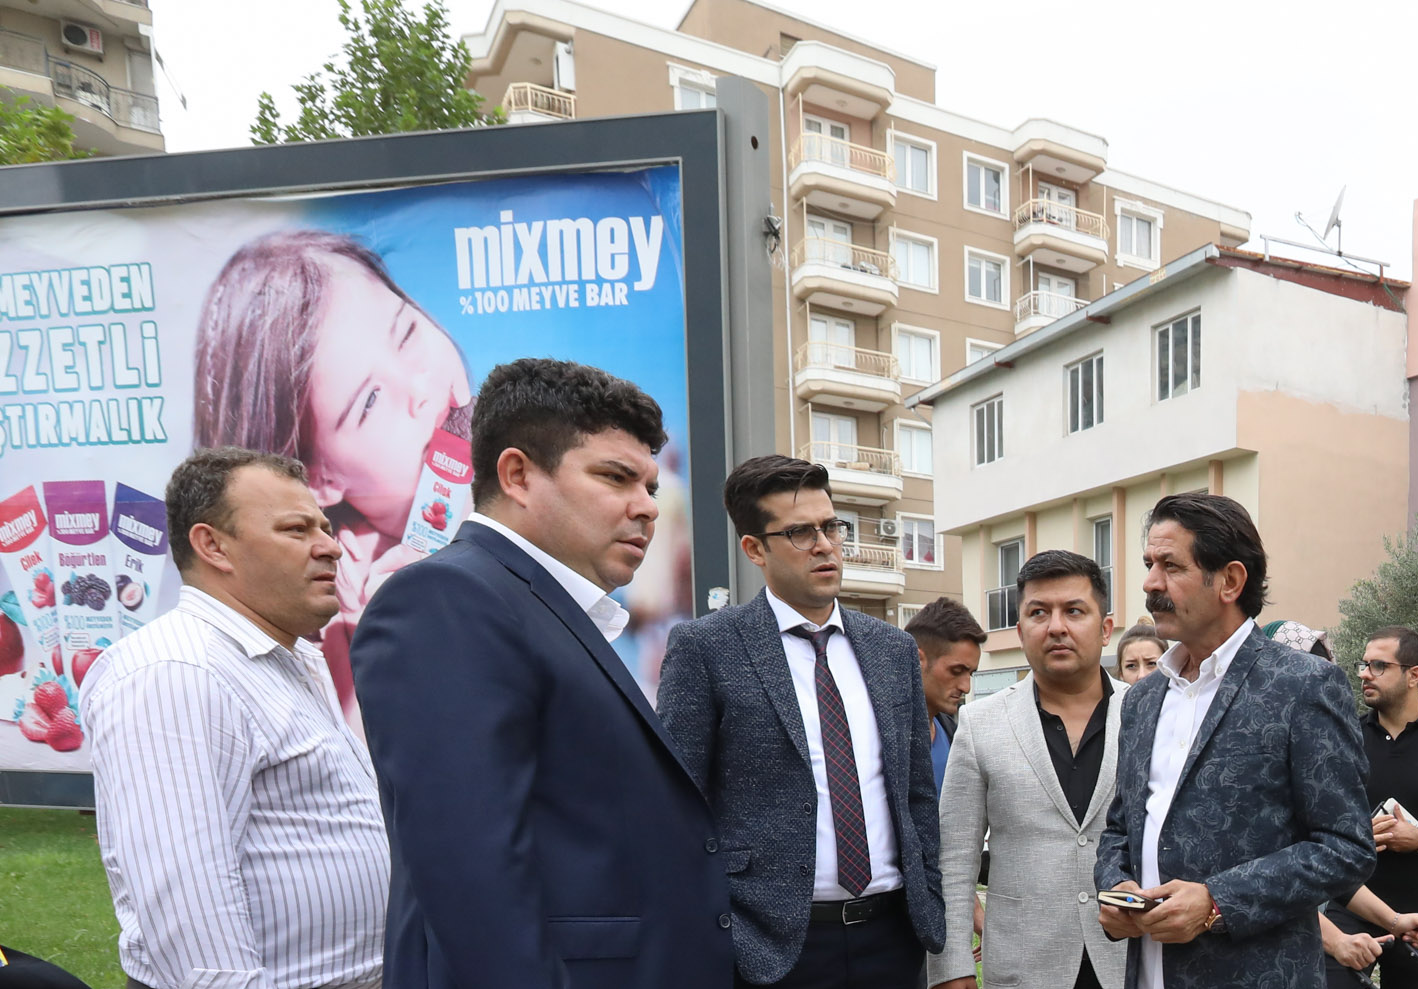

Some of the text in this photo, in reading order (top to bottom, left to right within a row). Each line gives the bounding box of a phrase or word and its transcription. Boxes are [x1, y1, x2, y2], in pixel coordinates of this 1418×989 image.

[454, 210, 664, 291] mixmey
[459, 282, 629, 315] %100 MEYVE BAR
[54, 510, 100, 531] mixmey
[117, 513, 163, 546] mixmey
